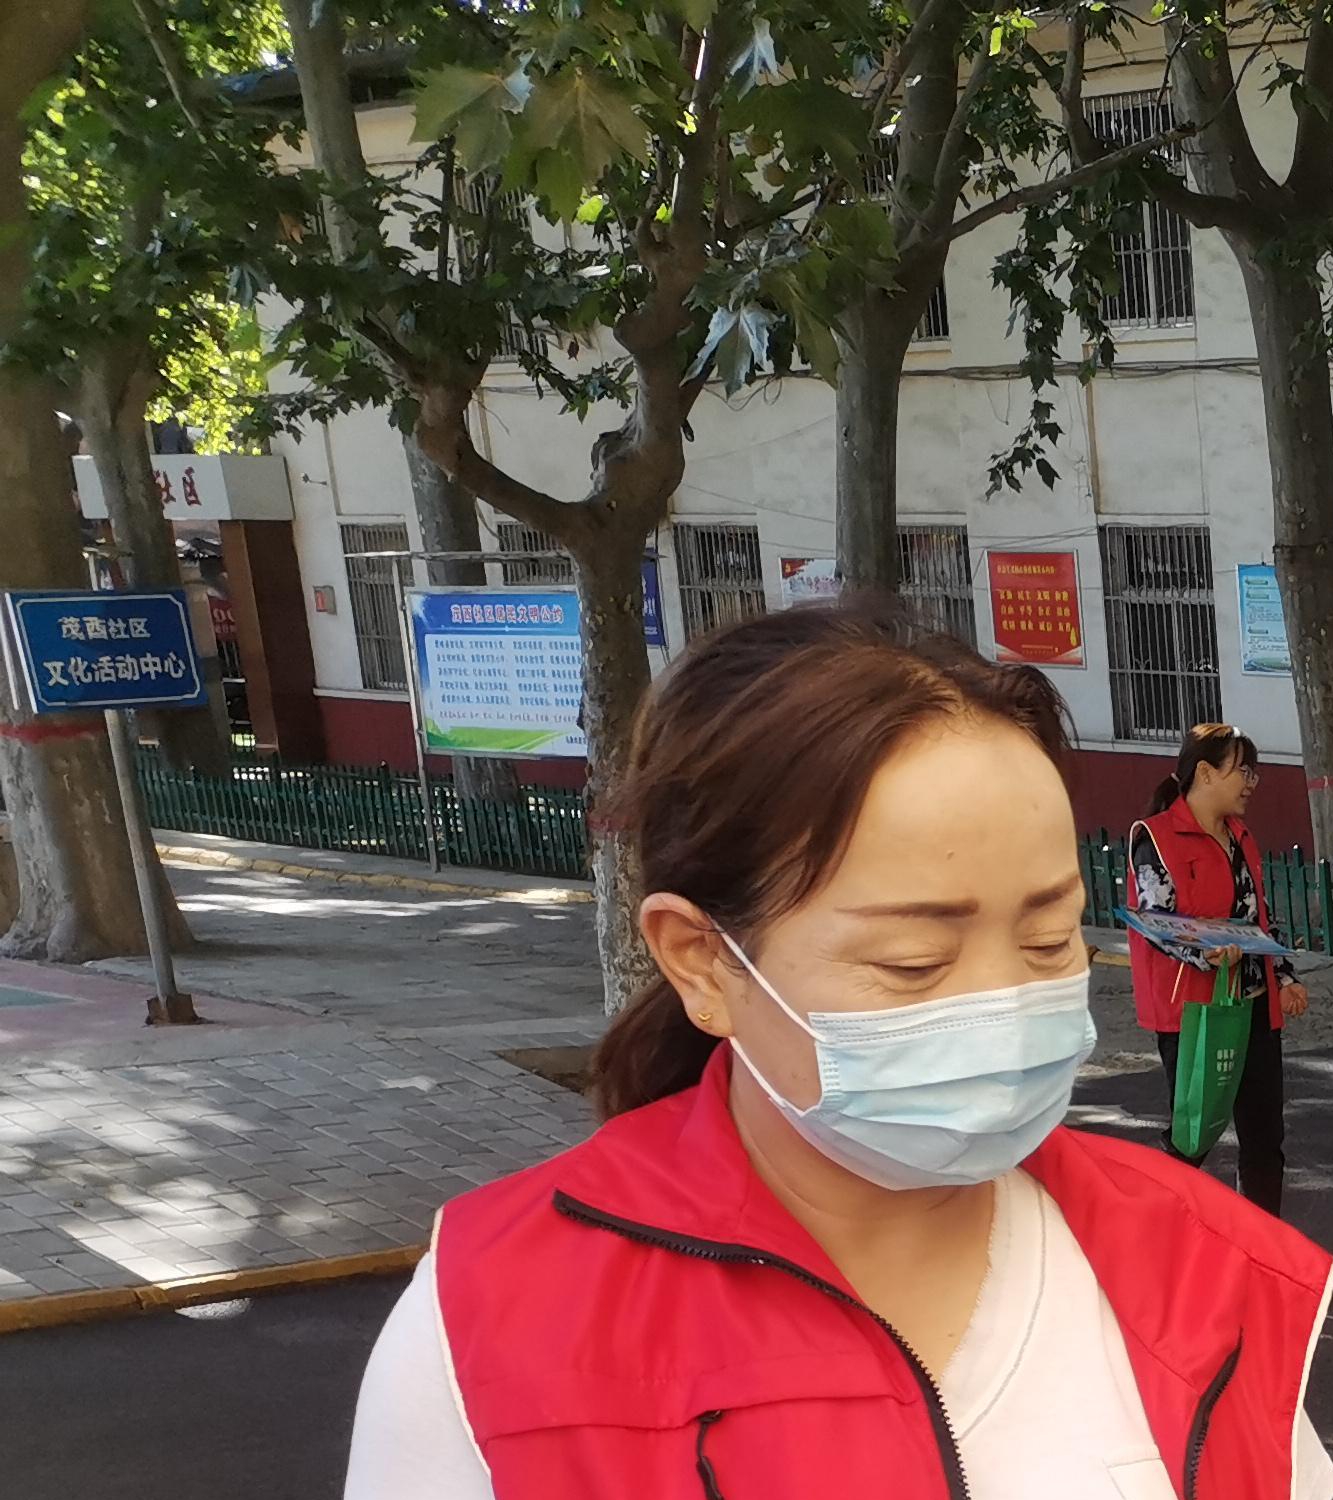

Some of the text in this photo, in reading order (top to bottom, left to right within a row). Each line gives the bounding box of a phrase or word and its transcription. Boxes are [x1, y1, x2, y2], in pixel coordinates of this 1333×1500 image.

[57, 616, 151, 640] 茂西社区
[43, 651, 187, 687] 文化活动中心
